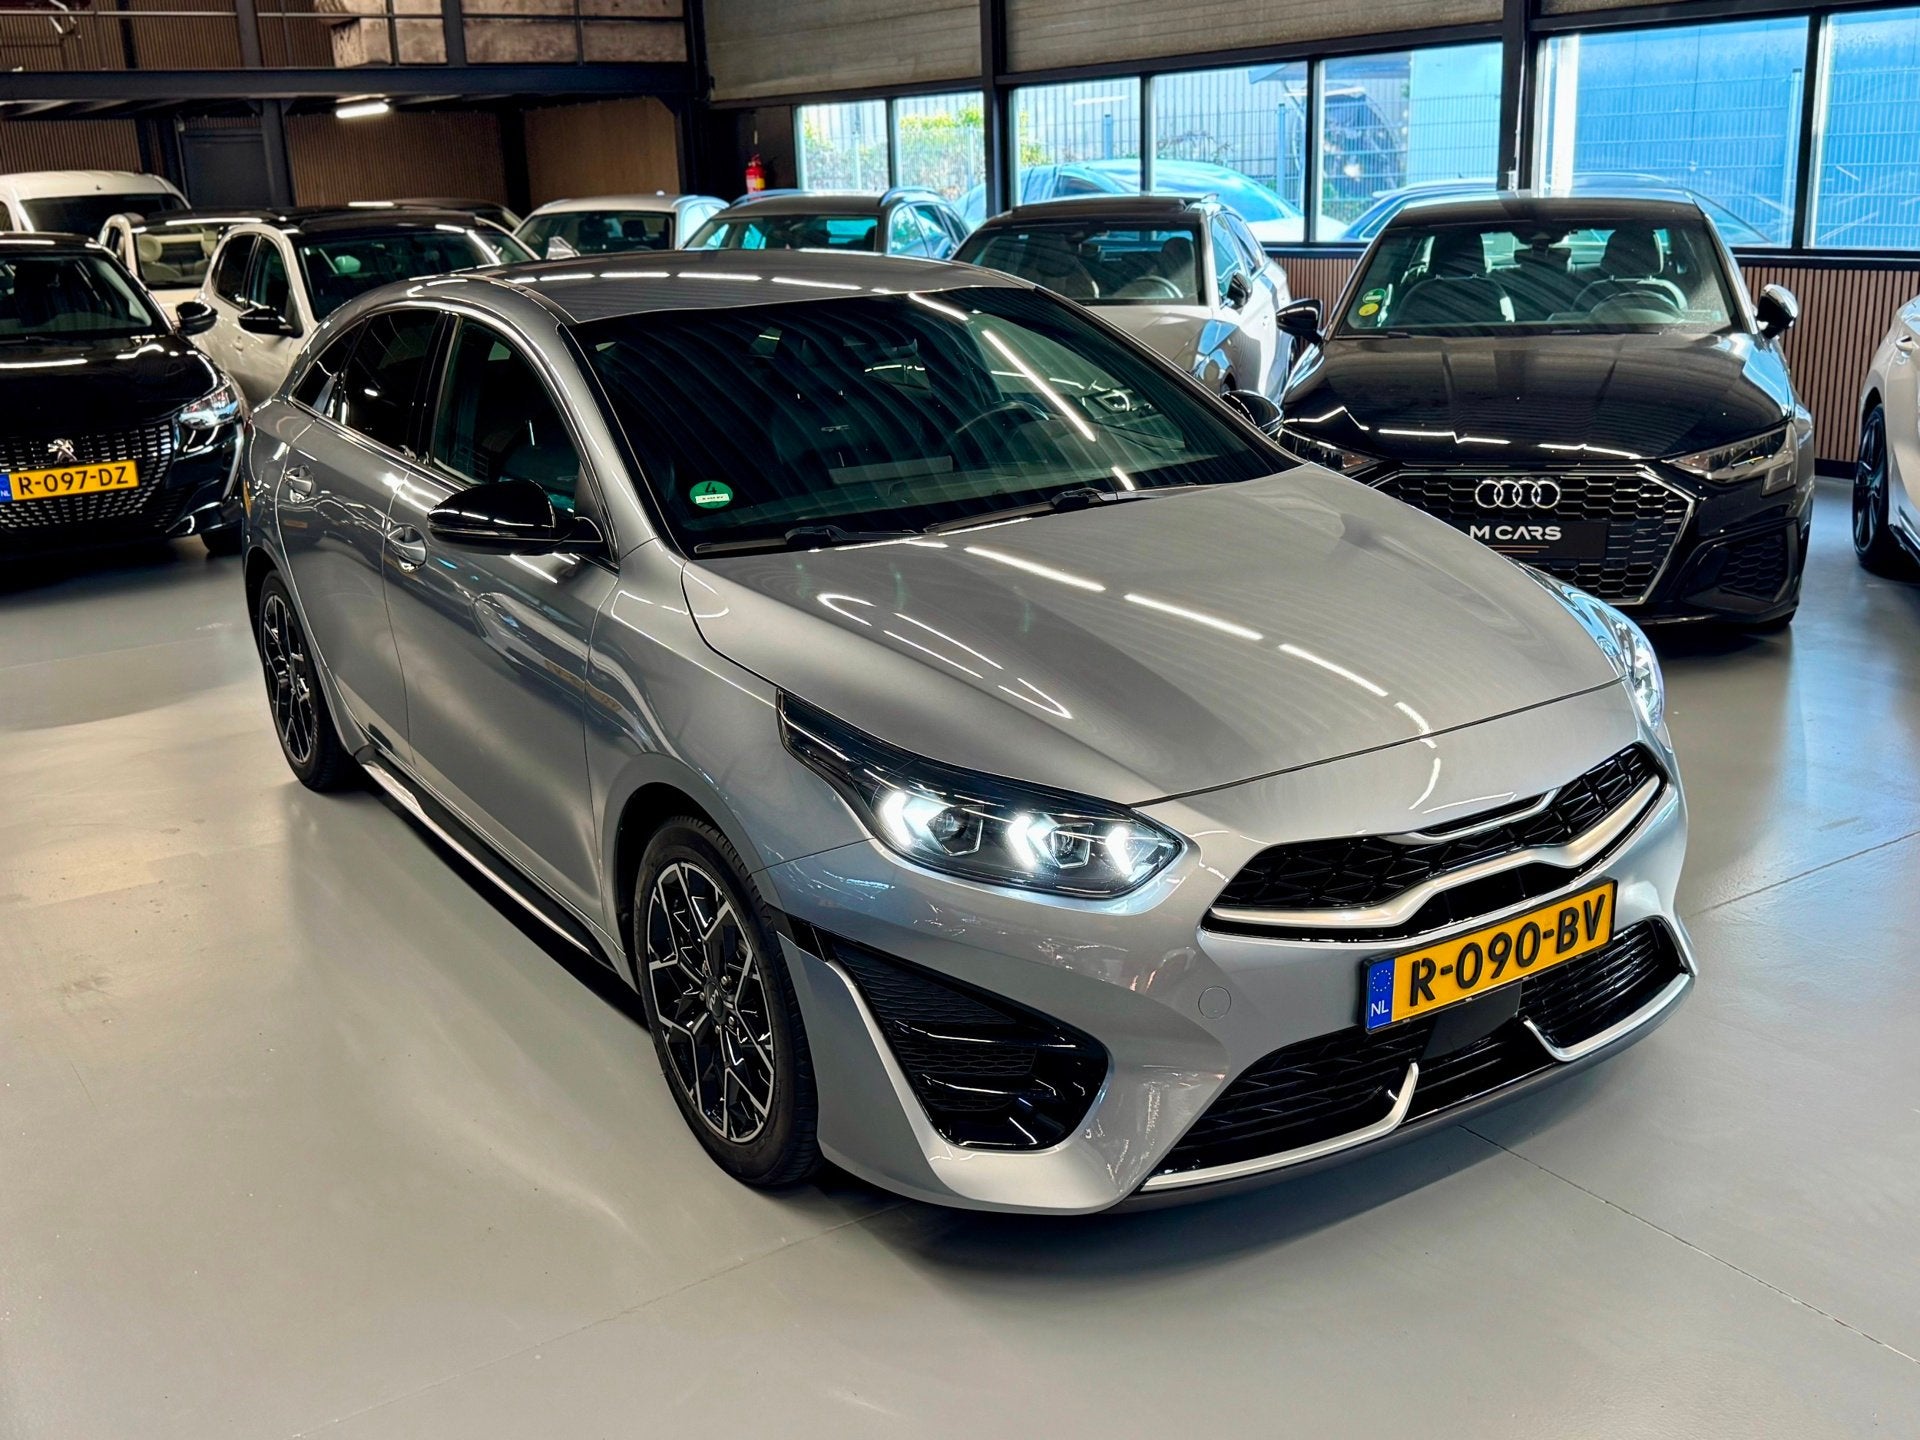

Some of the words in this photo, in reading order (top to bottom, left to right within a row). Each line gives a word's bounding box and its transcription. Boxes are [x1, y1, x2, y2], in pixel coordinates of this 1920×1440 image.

[18, 466, 128, 495] R-097-DZ
[705, 482, 717, 494] 4
[1470, 525, 1490, 540] M
[1495, 525, 1562, 540] CARS
[1410, 894, 1606, 1007] R-090-BV
[1371, 999, 1390, 1017] NL
